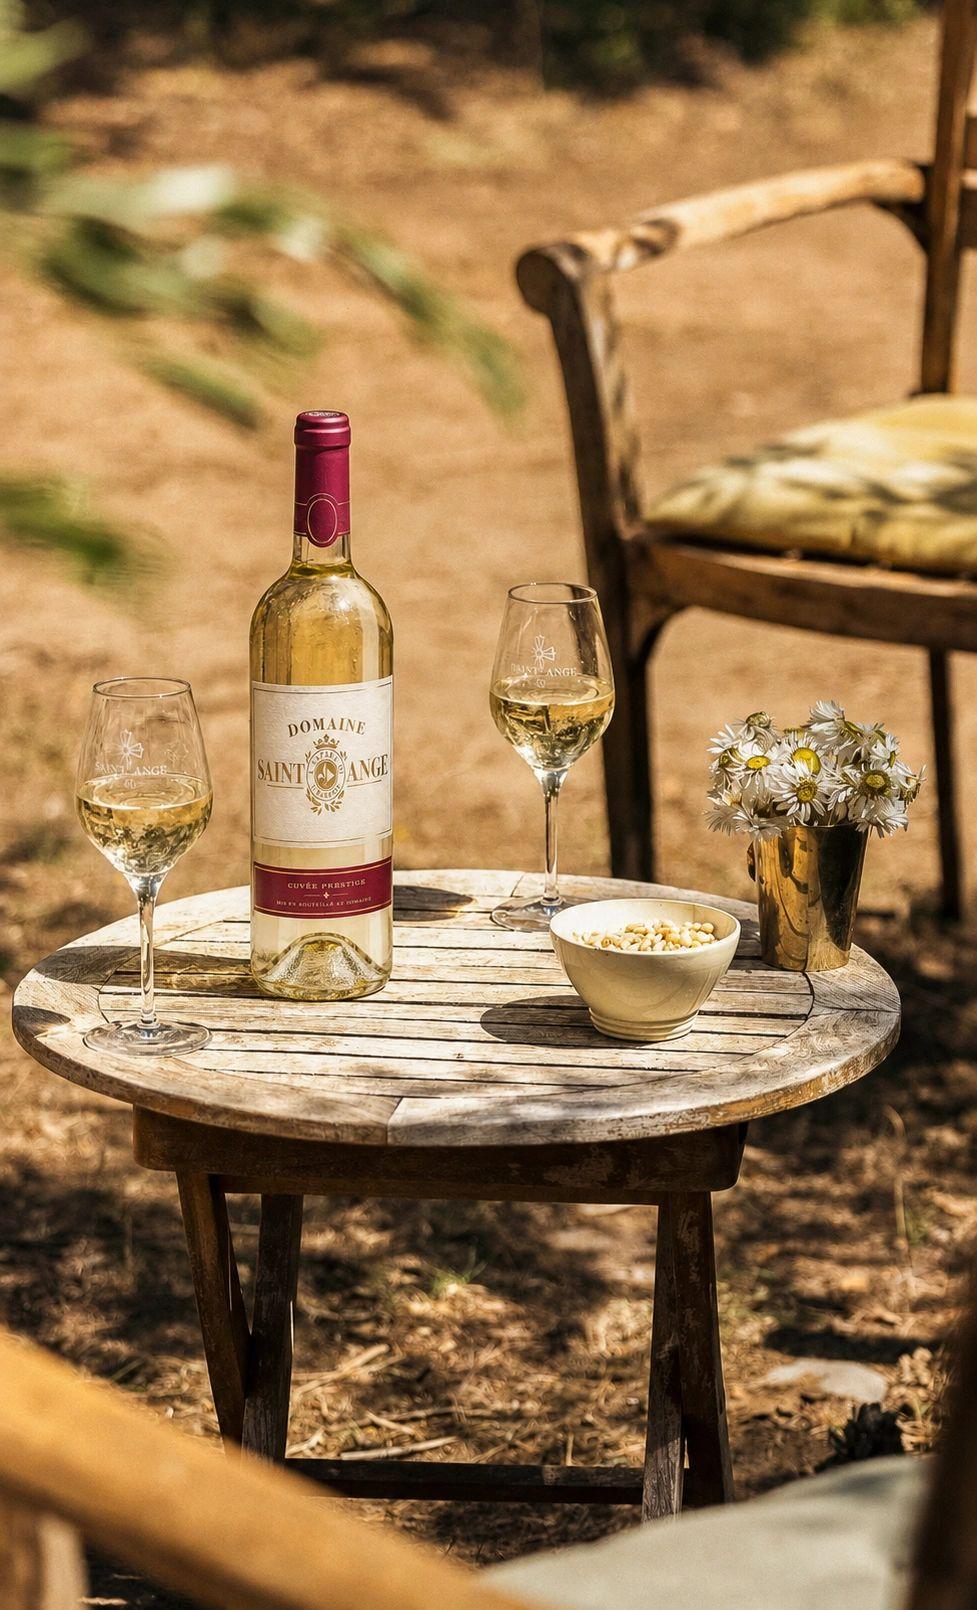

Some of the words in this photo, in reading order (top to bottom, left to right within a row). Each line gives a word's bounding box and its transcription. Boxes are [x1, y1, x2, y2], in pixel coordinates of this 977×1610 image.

[546, 667, 578, 677] ANGE
[287, 717, 366, 738] DOMAINE
[134, 765, 167, 776] ANGE
[257, 758, 305, 785] SAINT
[346, 753, 389, 782] ANGE
[287, 882, 318, 890] CUVÉE
[322, 879, 367, 889] PRESTIGE
